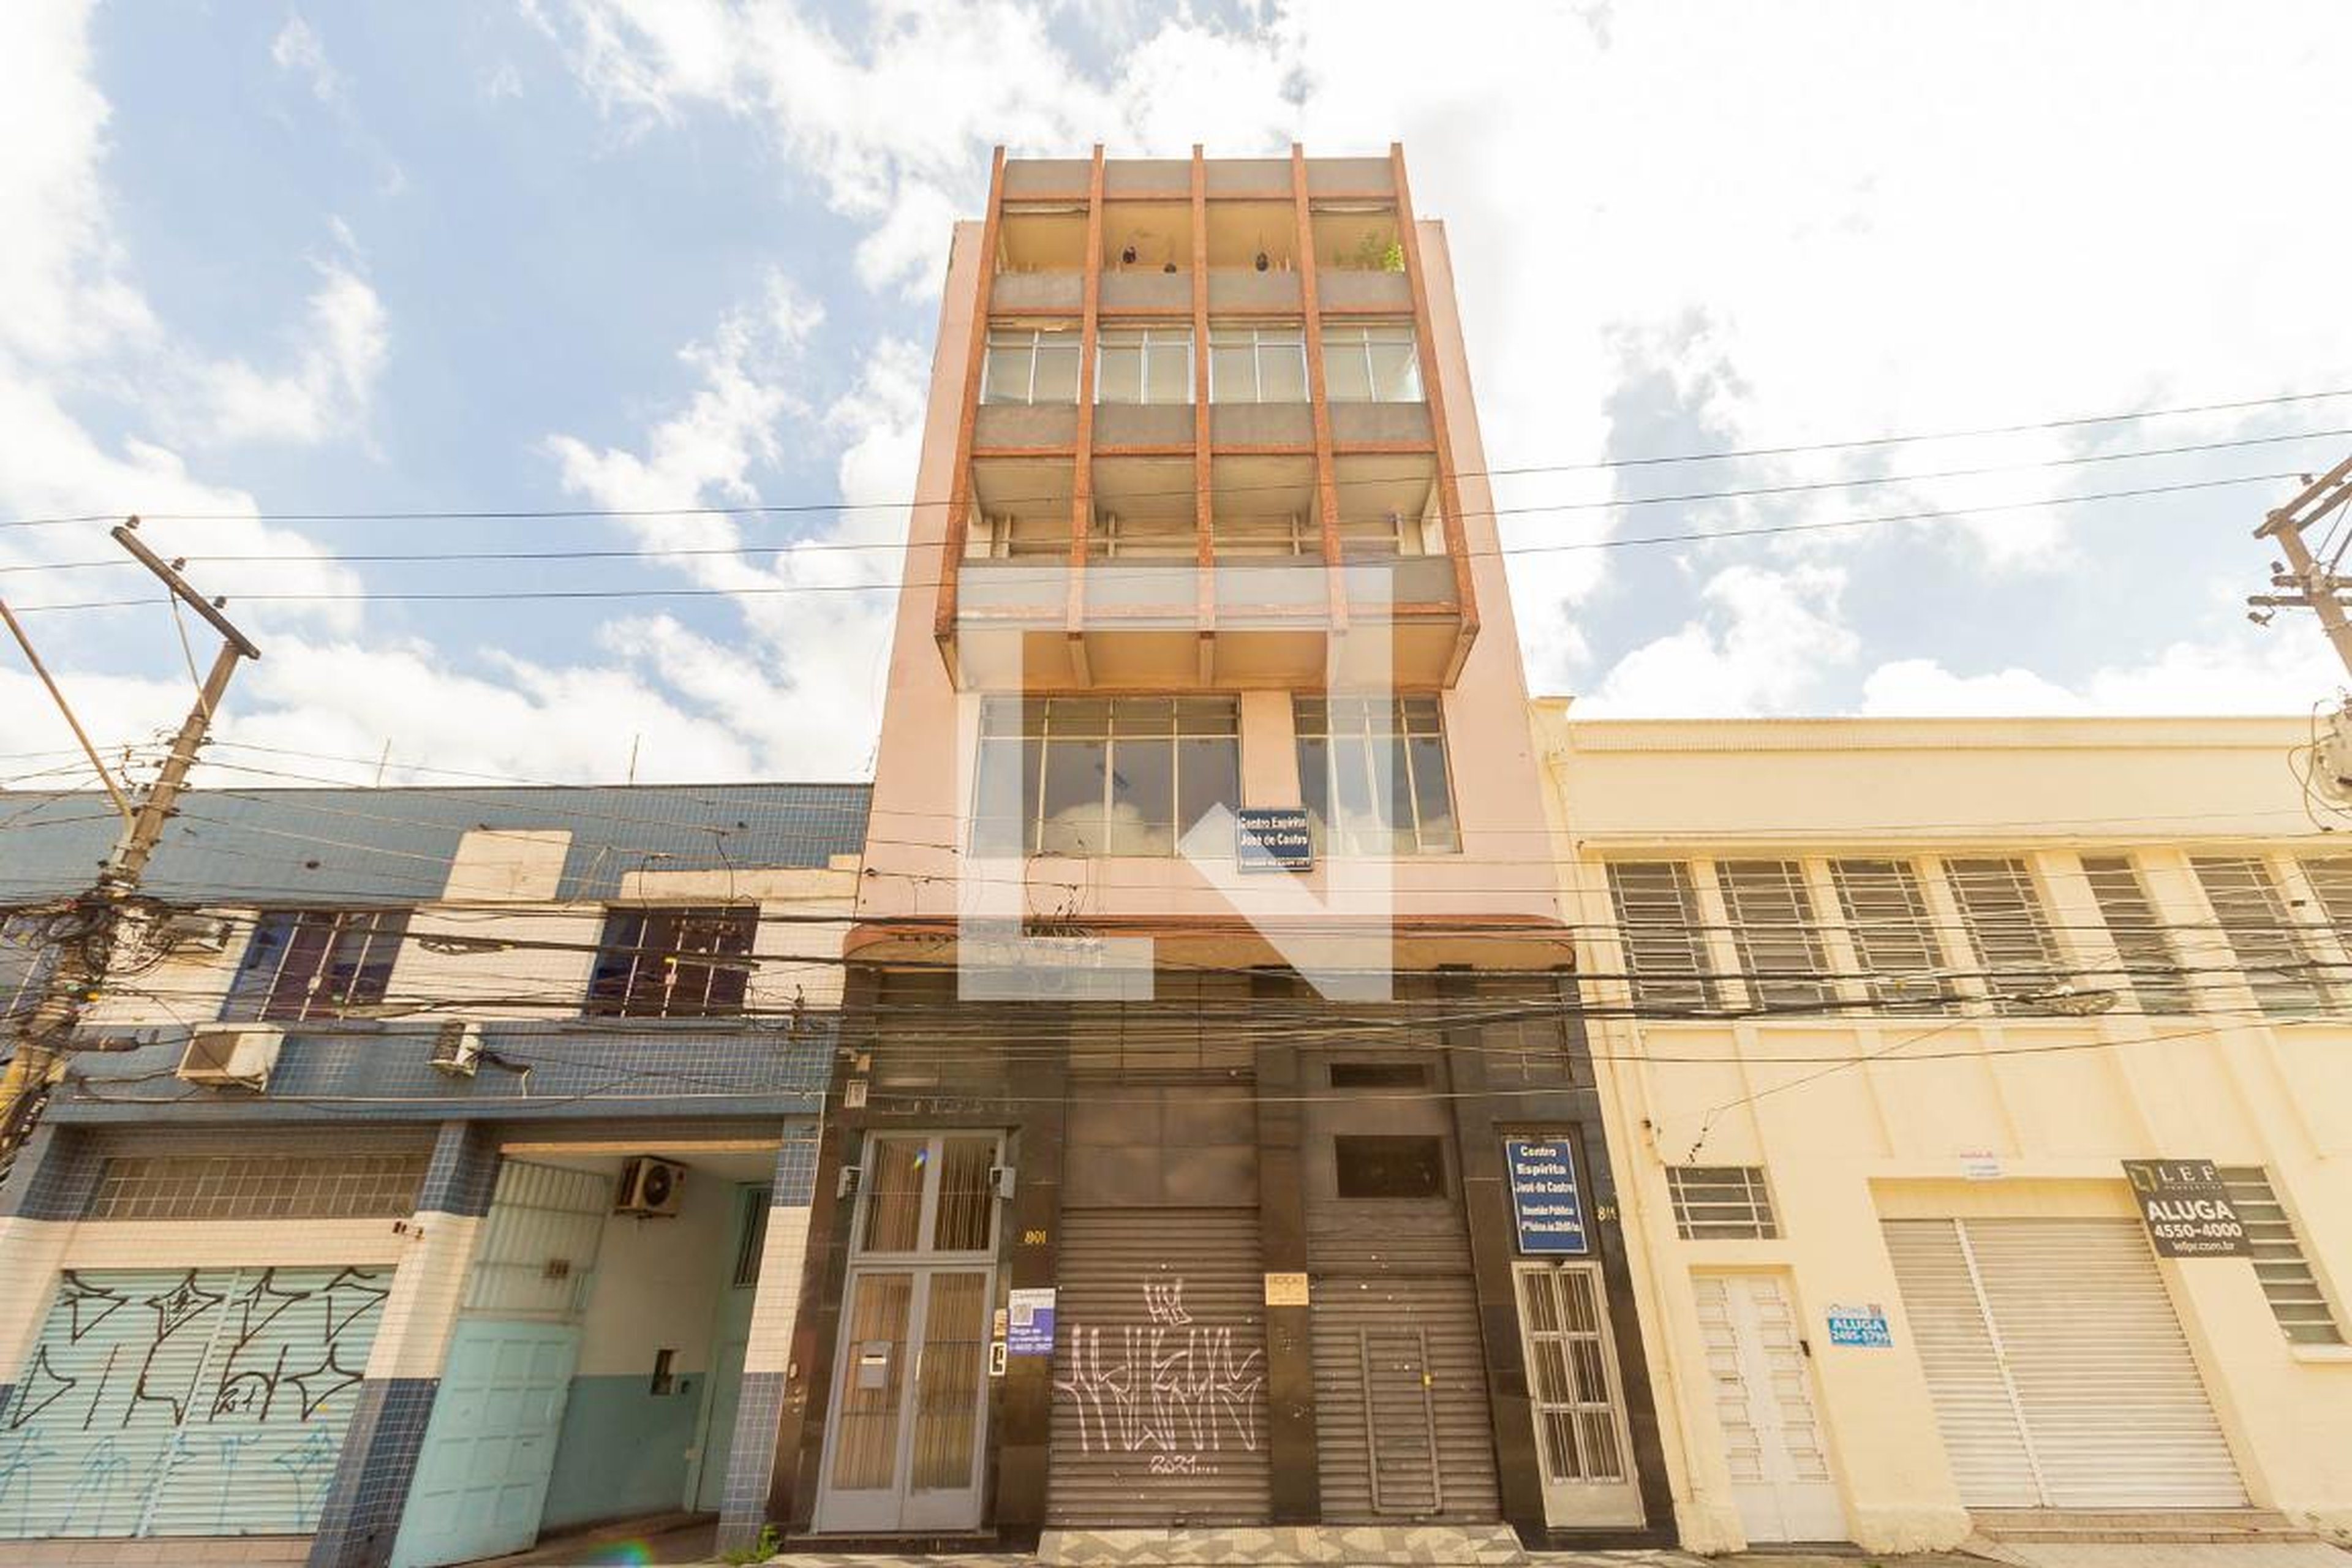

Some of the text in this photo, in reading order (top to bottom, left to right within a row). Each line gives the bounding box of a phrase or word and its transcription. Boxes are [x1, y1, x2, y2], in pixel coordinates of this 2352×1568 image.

[1520, 1145, 1556, 1157] Centro
[2148, 1200, 2236, 1221] ALUGA
[1024, 1230, 1047, 1244] 801
[2155, 1223, 2242, 1238] 4550-4000
[1832, 1319, 1885, 1331] ALUGA
